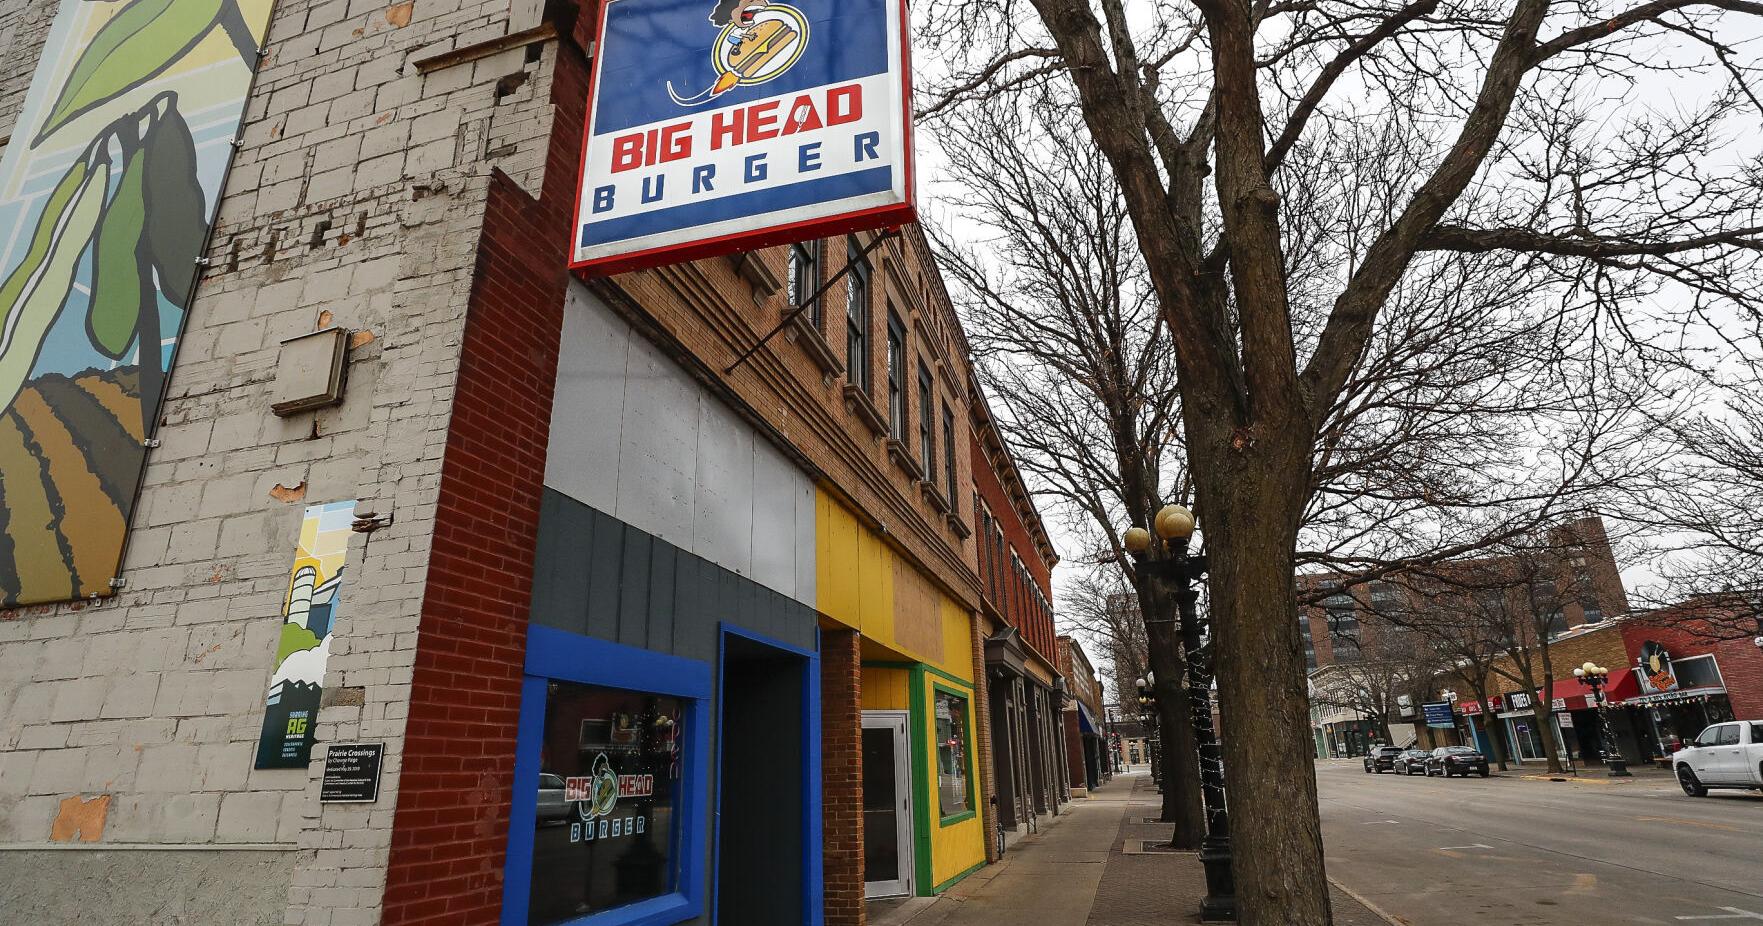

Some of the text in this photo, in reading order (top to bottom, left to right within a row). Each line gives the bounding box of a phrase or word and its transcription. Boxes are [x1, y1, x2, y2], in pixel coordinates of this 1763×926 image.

[611, 83, 863, 174] BIG HEAD
[592, 131, 880, 214] BURGER
[287, 718, 307, 734] AG
[329, 749, 376, 758] Prairie Crossings
[565, 774, 653, 802] BIG HEAD
[570, 816, 645, 842] BURGER
